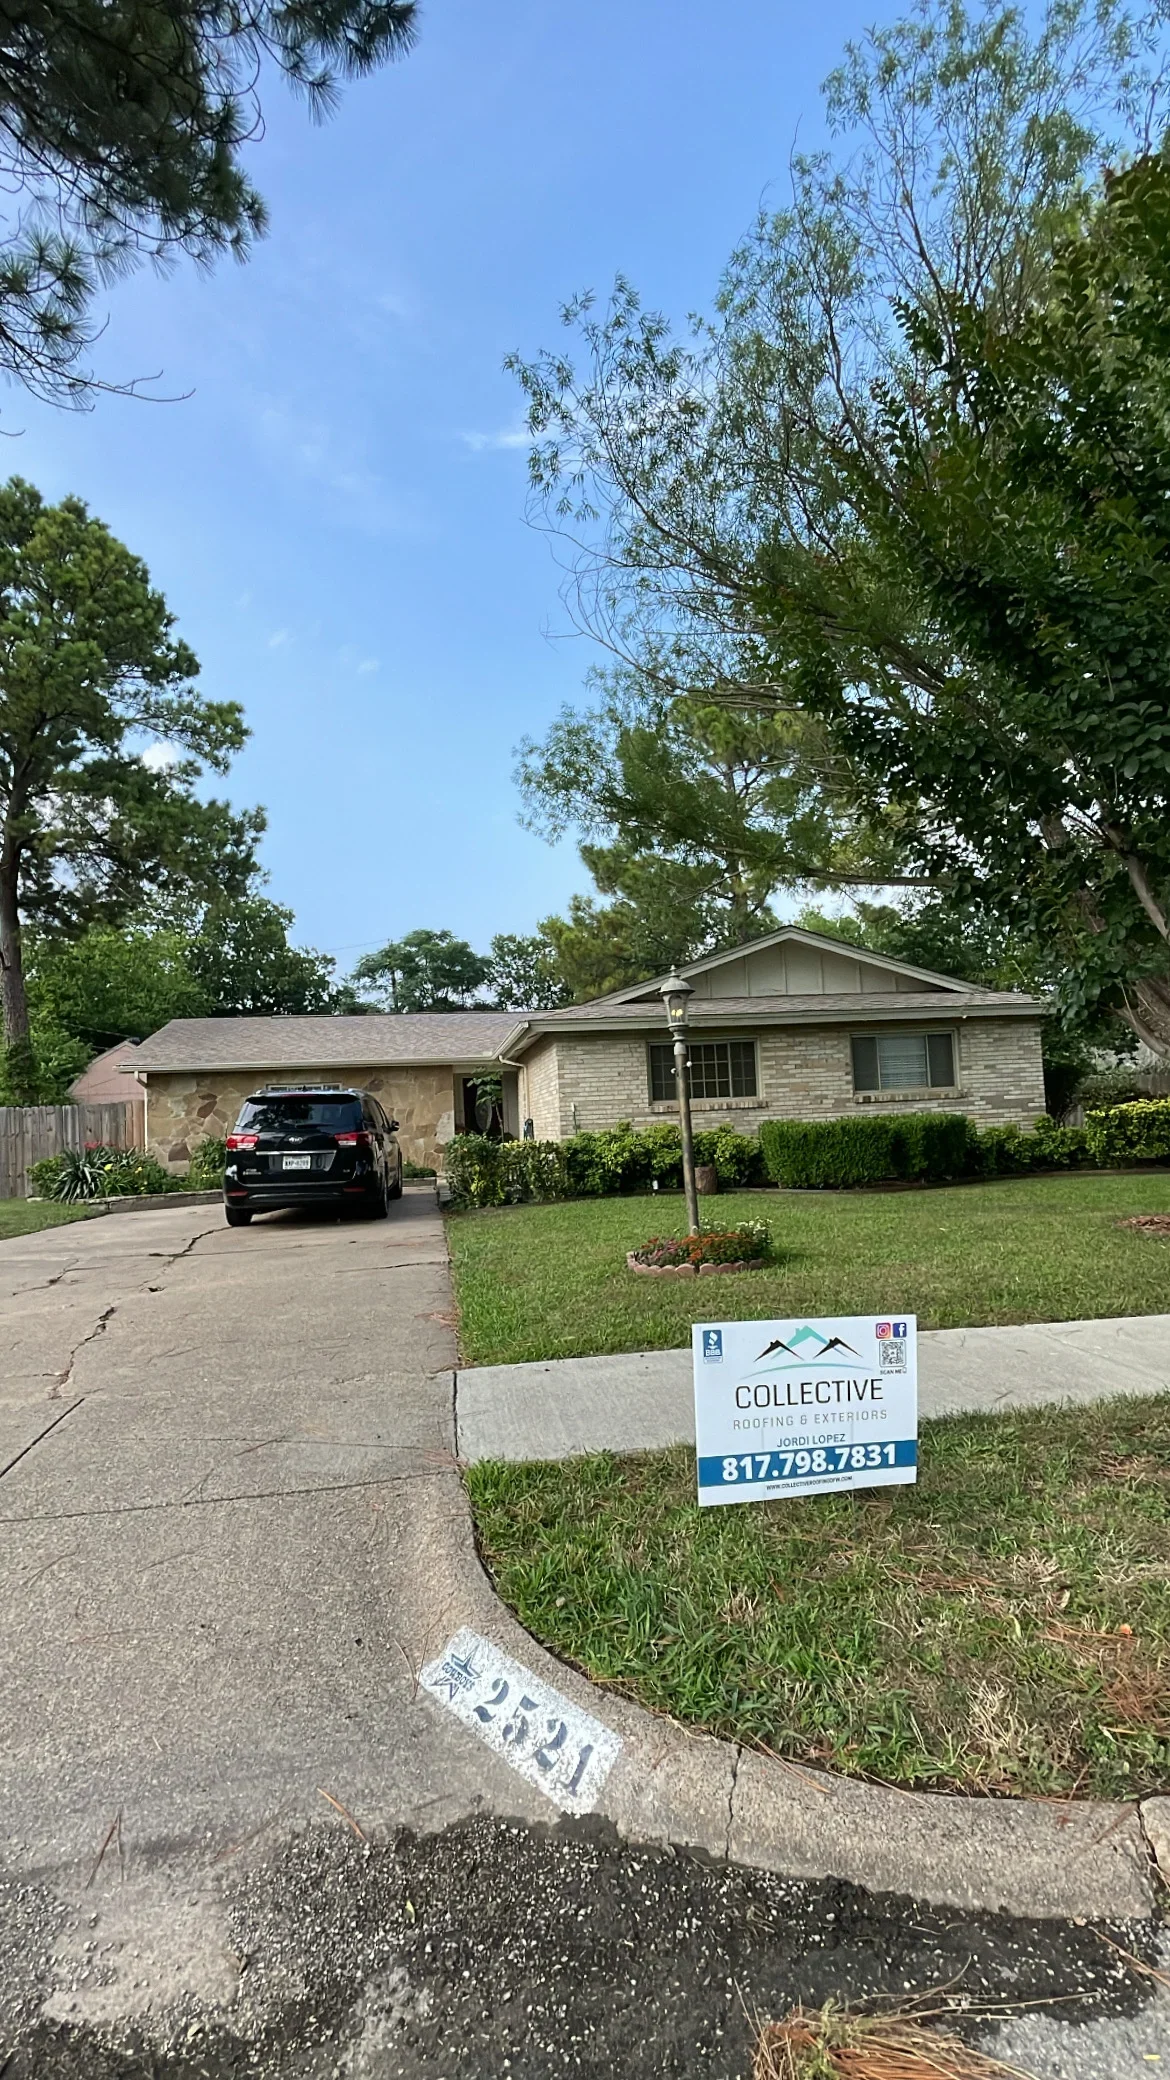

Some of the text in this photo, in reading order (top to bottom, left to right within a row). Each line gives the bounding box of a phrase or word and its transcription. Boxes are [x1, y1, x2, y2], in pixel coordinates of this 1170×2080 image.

[705, 1348, 721, 1356] BBB
[735, 1378, 884, 1409] COLLECTIVE
[733, 1409, 887, 1430] ROOFING & EXTERIORS
[777, 1433, 846, 1448] JORDI LOPEZ
[722, 1443, 896, 1482] 817.798.7831
[442, 1661, 476, 1692] COWBOYS
[473, 1677, 594, 1798] 2521
